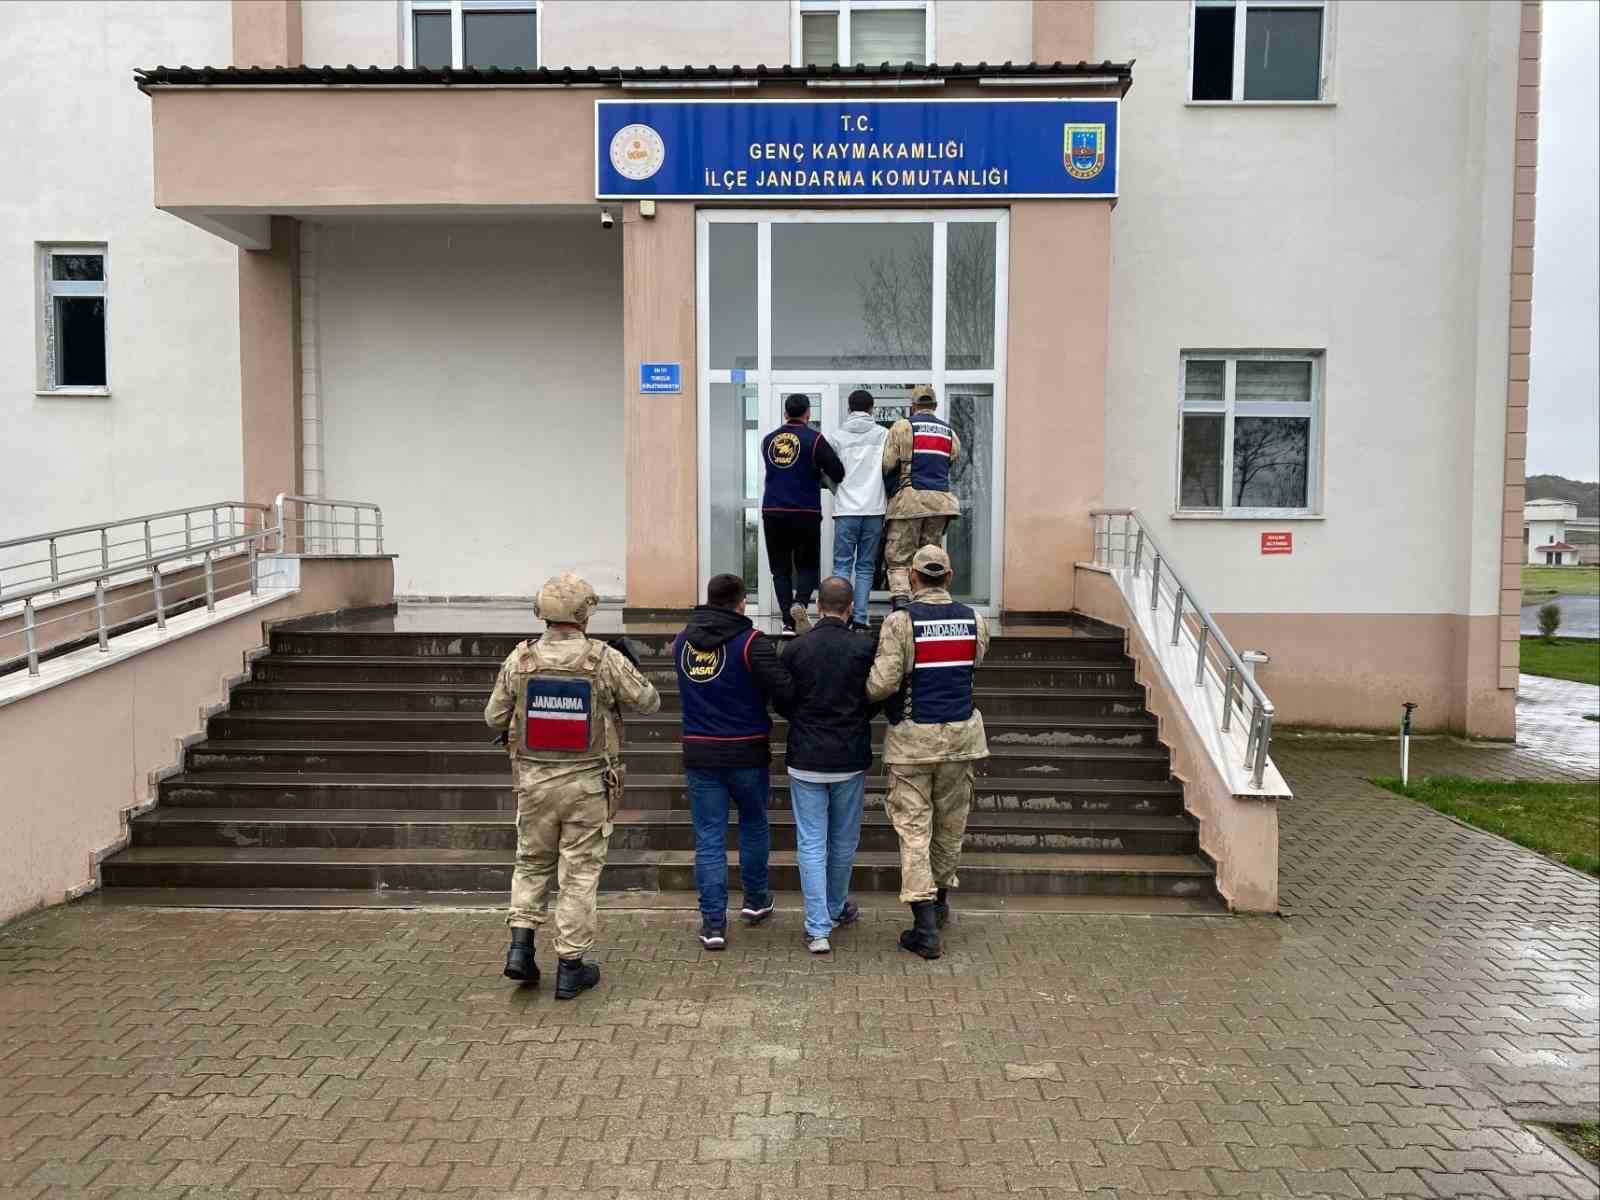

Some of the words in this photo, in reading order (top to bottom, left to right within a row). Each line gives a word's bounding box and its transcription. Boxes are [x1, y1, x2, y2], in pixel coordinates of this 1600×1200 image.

[840, 115, 873, 131] T.C.
[749, 143, 805, 163] GENÇ
[812, 140, 964, 159] KAYMAKAMLIĞI
[705, 167, 746, 190] İLÇE
[755, 170, 865, 186] JANDARMA
[871, 167, 1007, 186] KOMUTANLIĞI
[921, 624, 969, 637] JANDARMA
[689, 666, 715, 676] JASAT
[532, 696, 584, 710] JANDARMA
